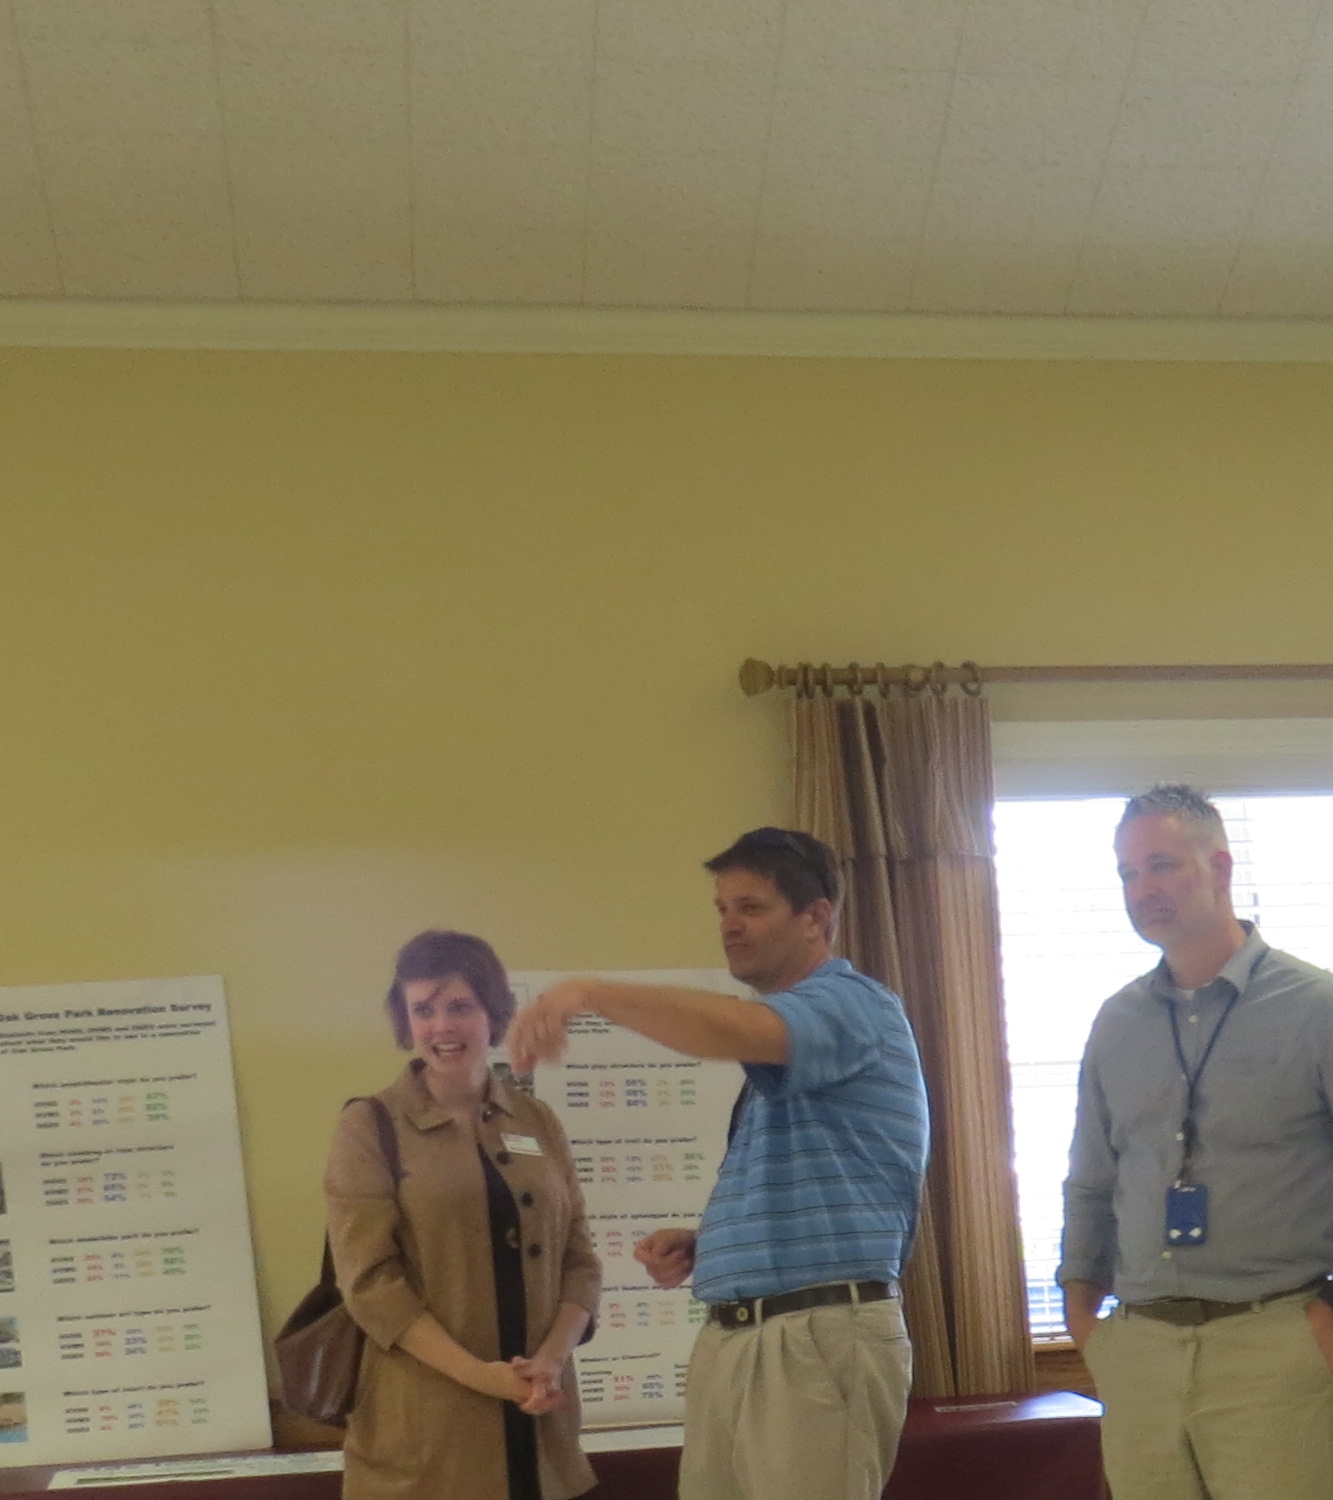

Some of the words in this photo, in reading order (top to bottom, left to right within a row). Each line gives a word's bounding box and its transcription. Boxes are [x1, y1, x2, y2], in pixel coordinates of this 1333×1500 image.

[63, 1009, 93, 1019] Park
[97, 1005, 167, 1017] Renovation
[170, 1003, 212, 1014] Survey
